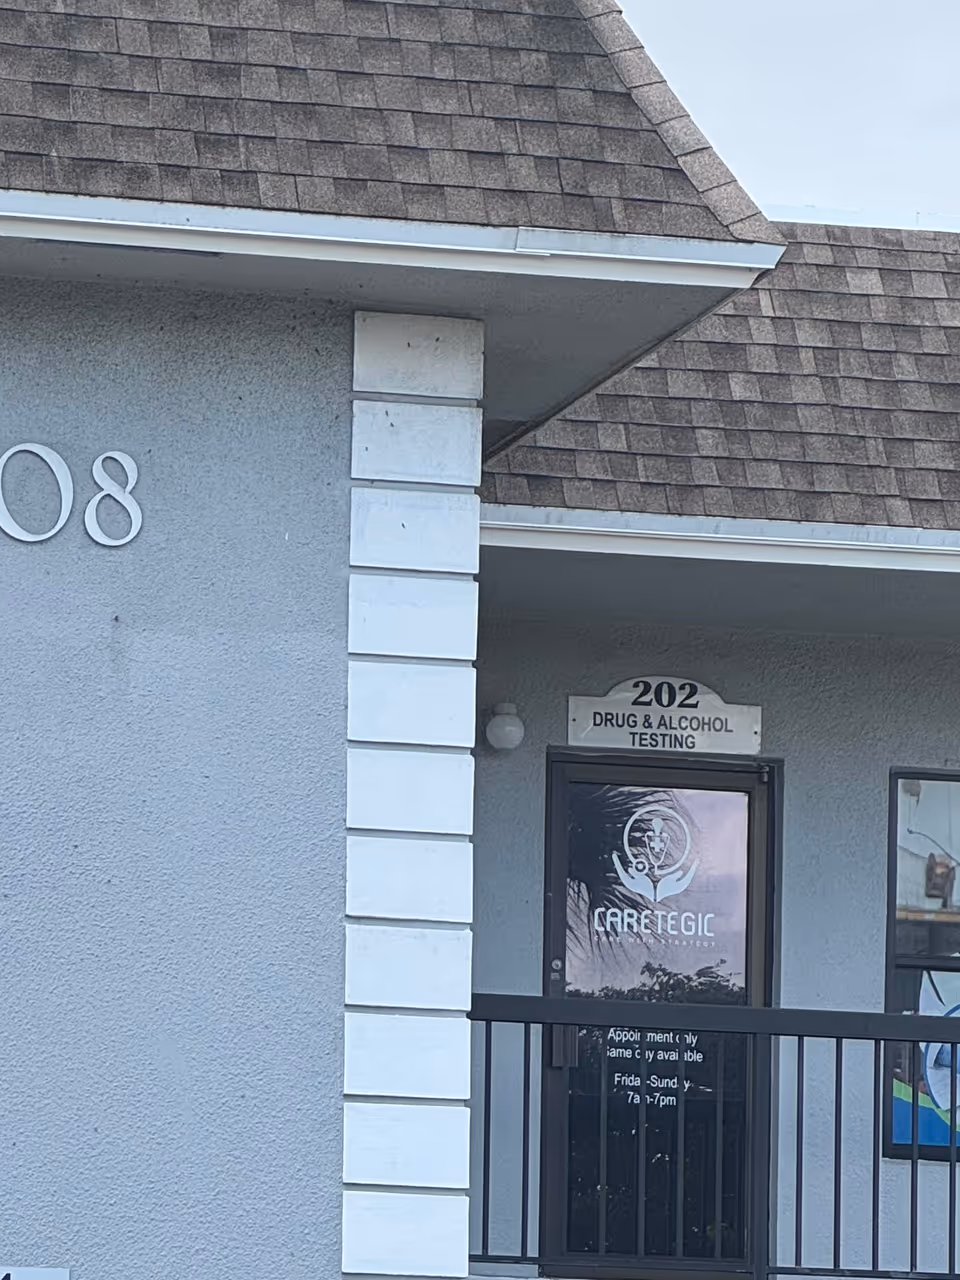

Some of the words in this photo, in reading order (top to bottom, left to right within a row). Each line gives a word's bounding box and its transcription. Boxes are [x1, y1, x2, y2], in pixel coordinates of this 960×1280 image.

[631, 680, 700, 709] 202
[593, 711, 638, 729] DRUG
[642, 714, 653, 729] &
[657, 714, 734, 733] ALCOHOL
[629, 731, 696, 749] TESTING
[594, 907, 716, 937] CARETEGIC
[607, 1028, 674, 1044] Appoiment
[657, 1049, 704, 1063] avaiable
[614, 1073, 691, 1092] Frida-Sundy
